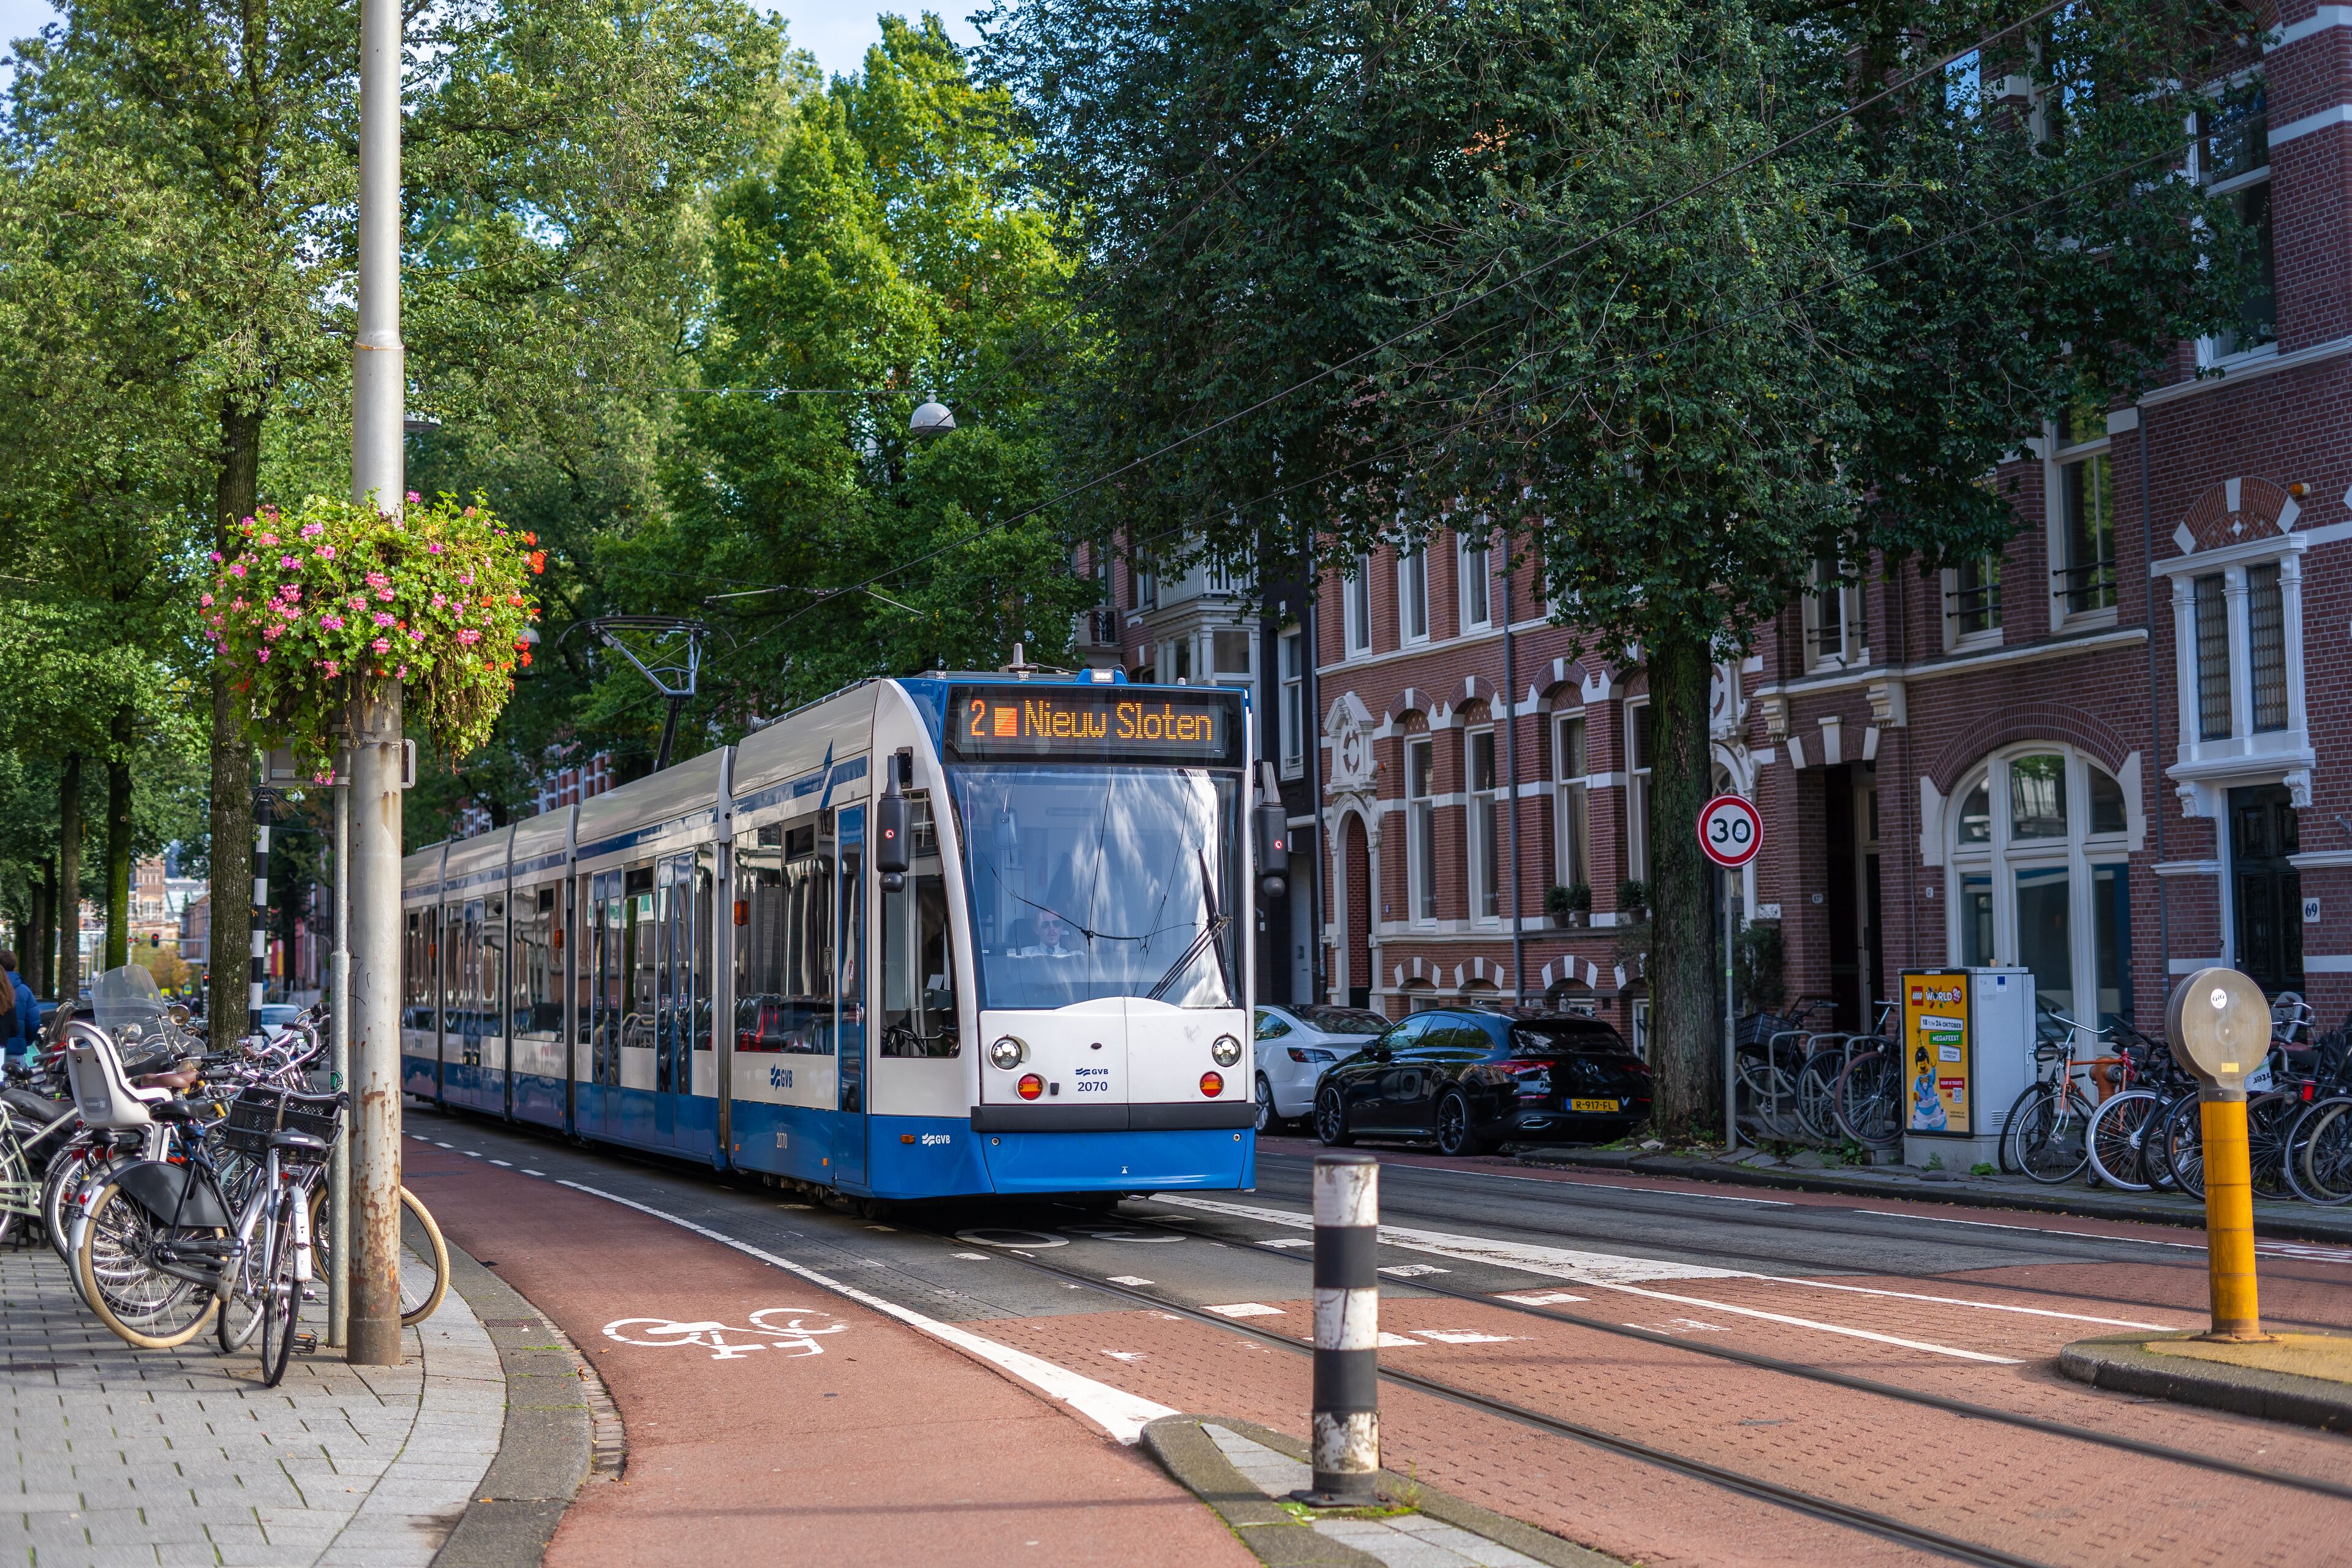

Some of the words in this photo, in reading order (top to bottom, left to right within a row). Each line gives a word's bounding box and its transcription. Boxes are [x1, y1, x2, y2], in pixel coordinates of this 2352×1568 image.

[970, 699, 985, 736] 2
[1025, 700, 1106, 737] Nieuw
[1117, 703, 1212, 741] Sloten
[1711, 818, 1751, 843] 30
[2305, 903, 2318, 918] 69
[1912, 992, 1923, 1000] LEGO
[1925, 991, 1952, 1001] WORLD
[1953, 987, 1961, 998] 20
[780, 1069, 793, 1088] GVB
[1077, 1081, 1108, 1091] 2070
[1576, 1101, 1613, 1110] R-917-FL
[777, 1132, 788, 1150] 2070
[935, 1135, 951, 1145] GVB
